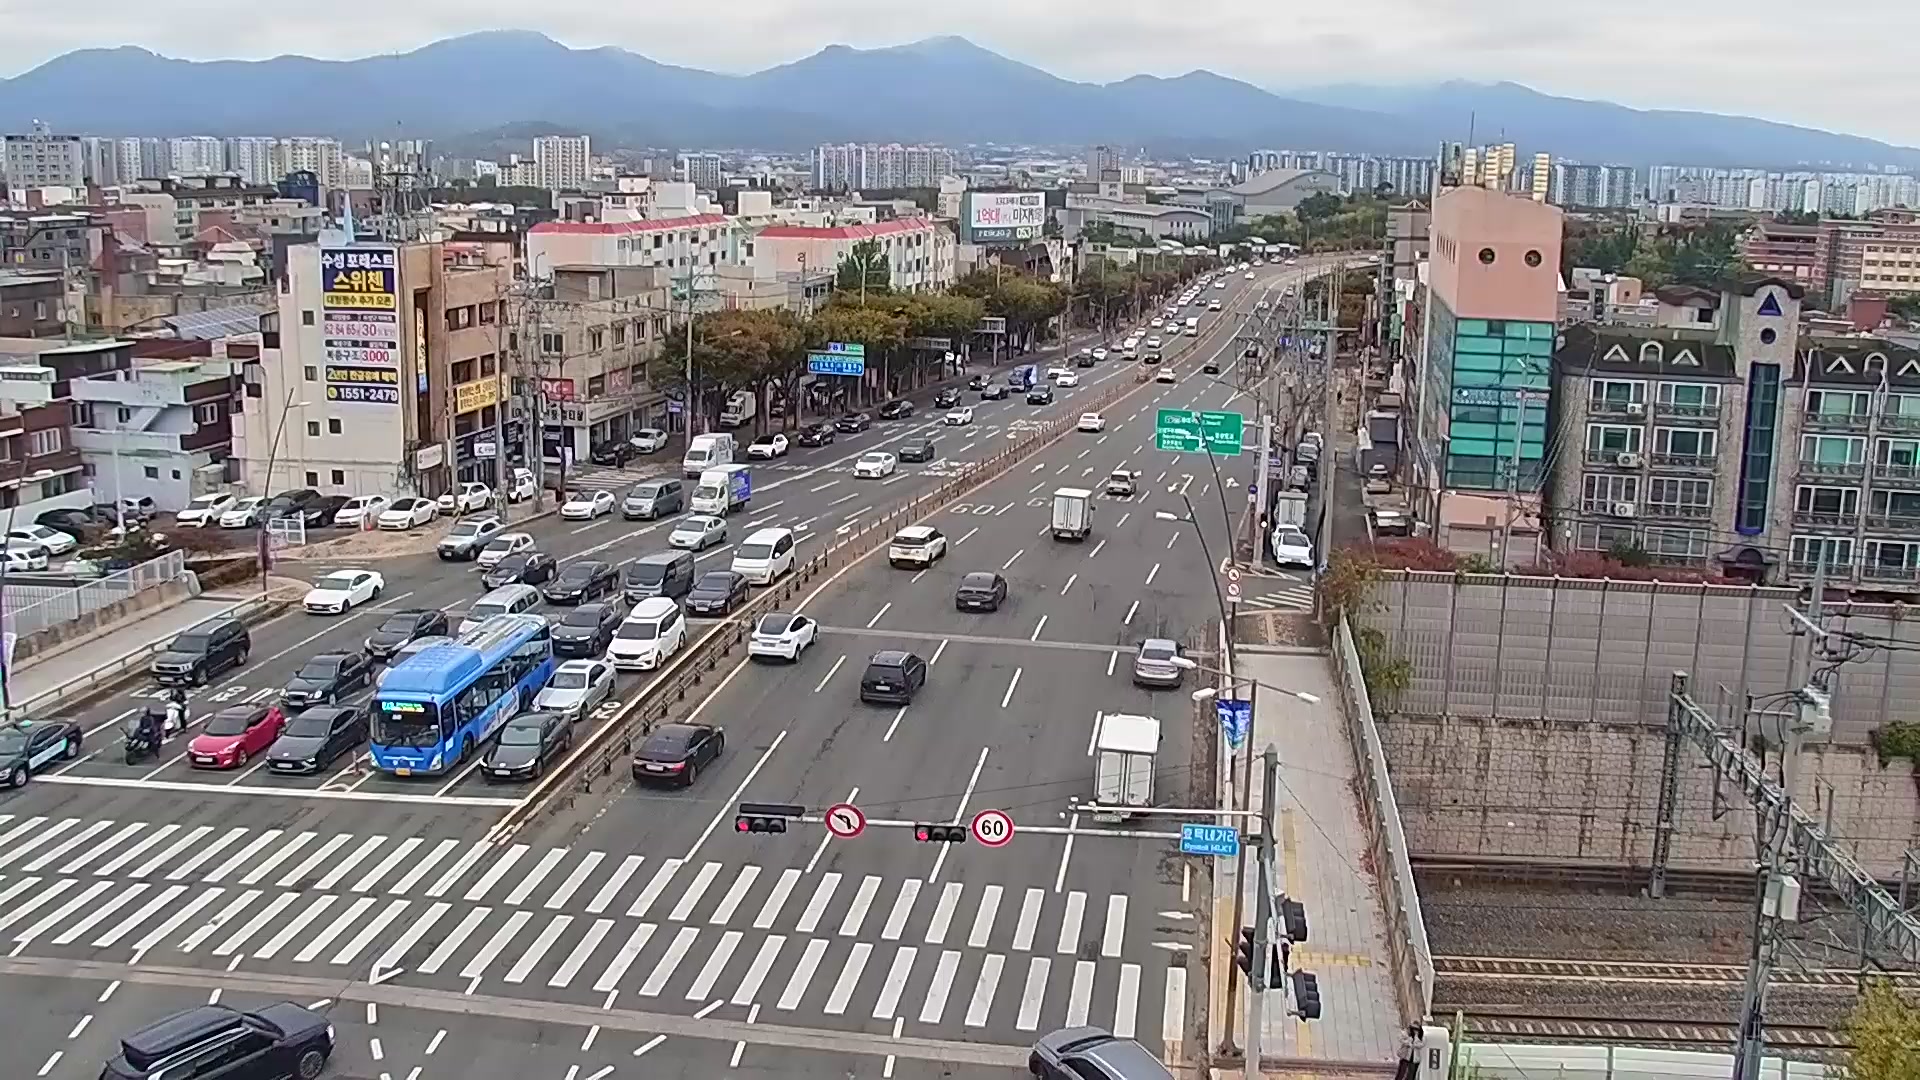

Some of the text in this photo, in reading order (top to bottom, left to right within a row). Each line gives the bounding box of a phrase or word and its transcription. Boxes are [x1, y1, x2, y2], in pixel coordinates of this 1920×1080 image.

[322, 252, 394, 269] 수성 포레스트
[333, 271, 384, 292] 스위첸
[376, 296, 392, 307] 오픈
[339, 387, 398, 401] 1551-2479
[981, 819, 1004, 836] 60
